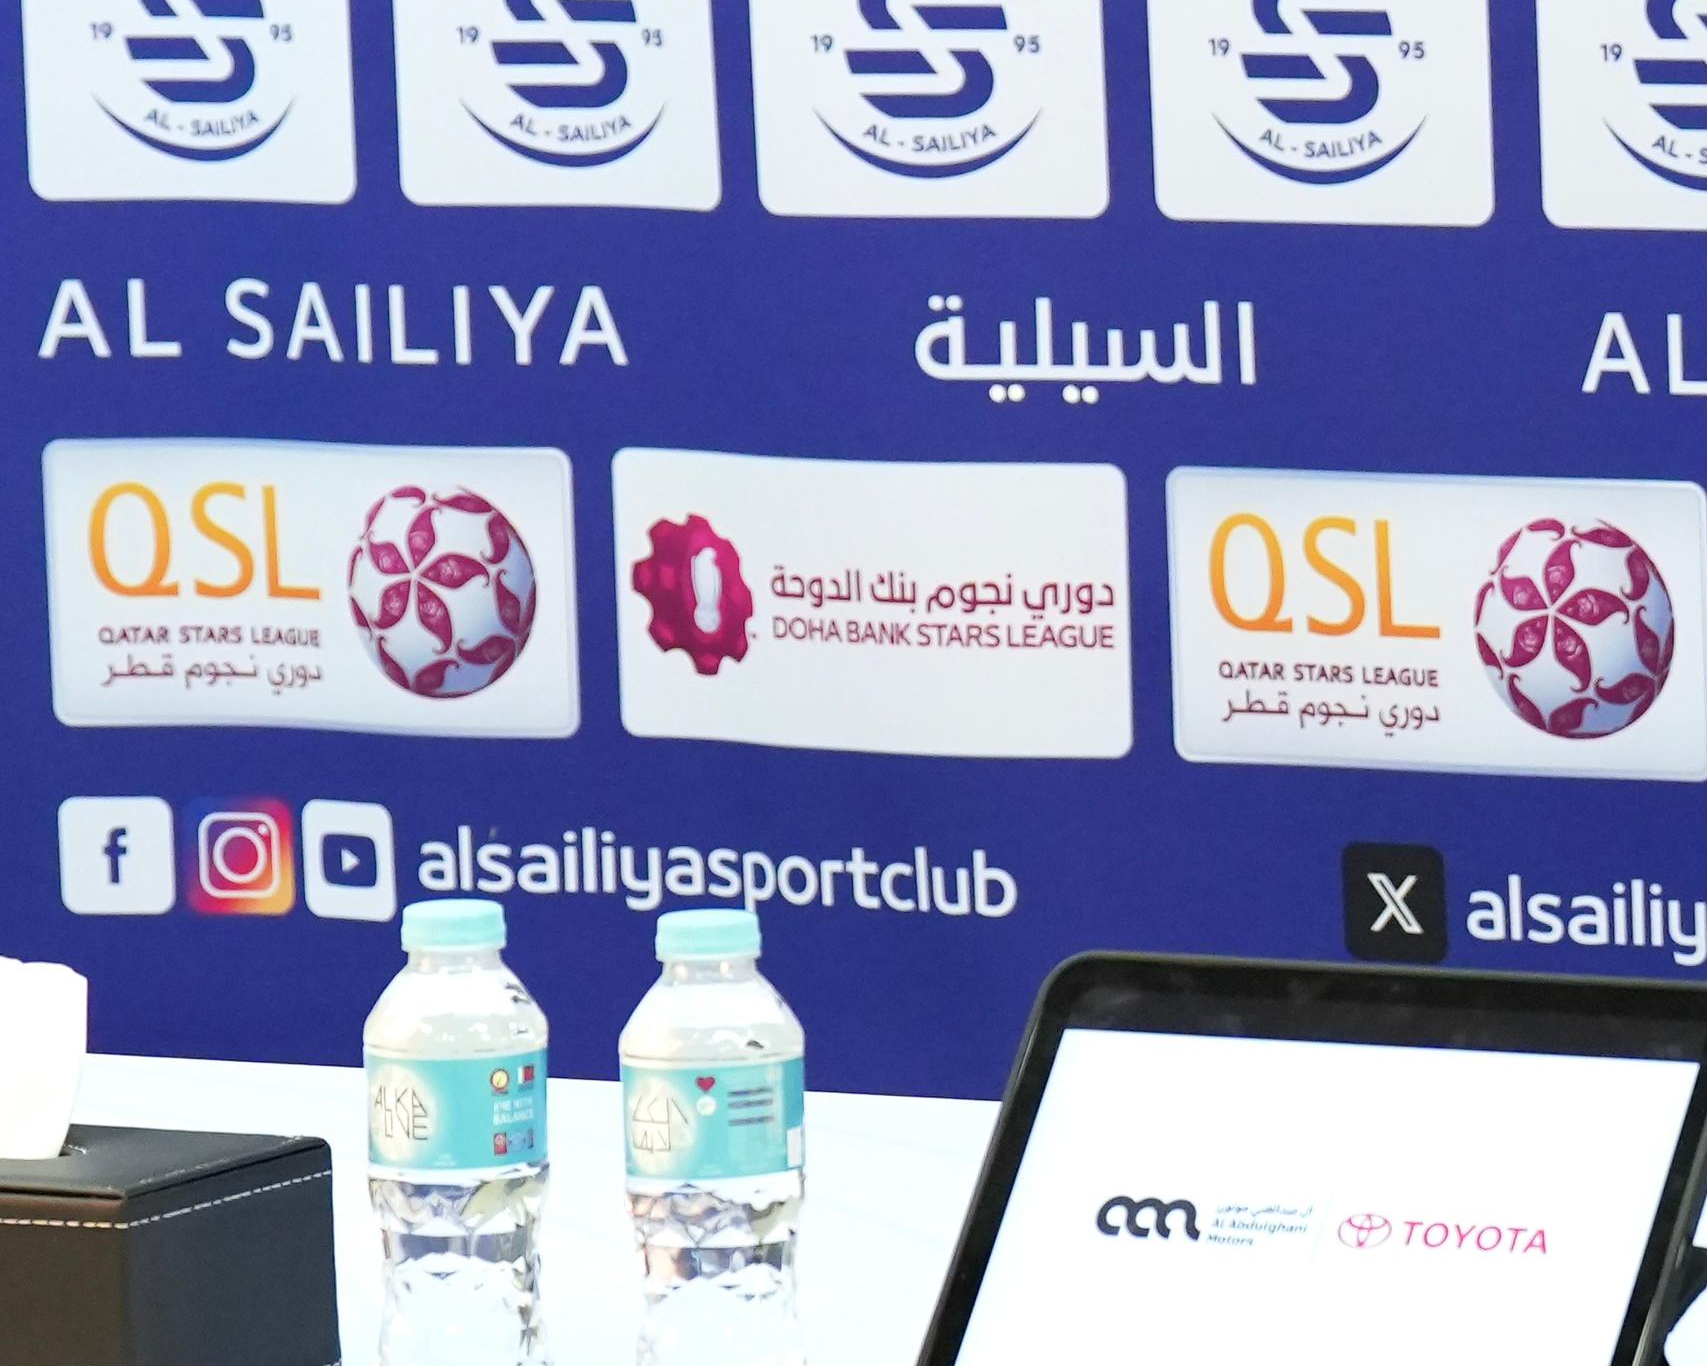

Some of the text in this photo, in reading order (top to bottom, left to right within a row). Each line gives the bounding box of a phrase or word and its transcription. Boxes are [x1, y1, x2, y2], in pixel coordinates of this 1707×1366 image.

[1599, 43, 1624, 64] 19
[1650, 134, 1680, 160] AL
[39, 278, 627, 365] AL SAILIYA
[916, 296, 1255, 403] السيلية
[89, 482, 320, 600] QSL
[769, 565, 1116, 621] دوري نجوم بنك الدوحة
[1210, 513, 1440, 639] QSL
[98, 626, 320, 648] QATAR STARS LEAGUE
[772, 616, 1115, 650] DOHA BANK STARS LEAGUE
[102, 654, 323, 696] دوري نجوم قطر
[1217, 661, 1440, 689] QATAR STARS LEAGUE
[1221, 690, 1441, 739] دوري نجوم قطر
[418, 826, 1017, 916] alsailiyasportclub
[1403, 1221, 1549, 1255] TOYOTA
